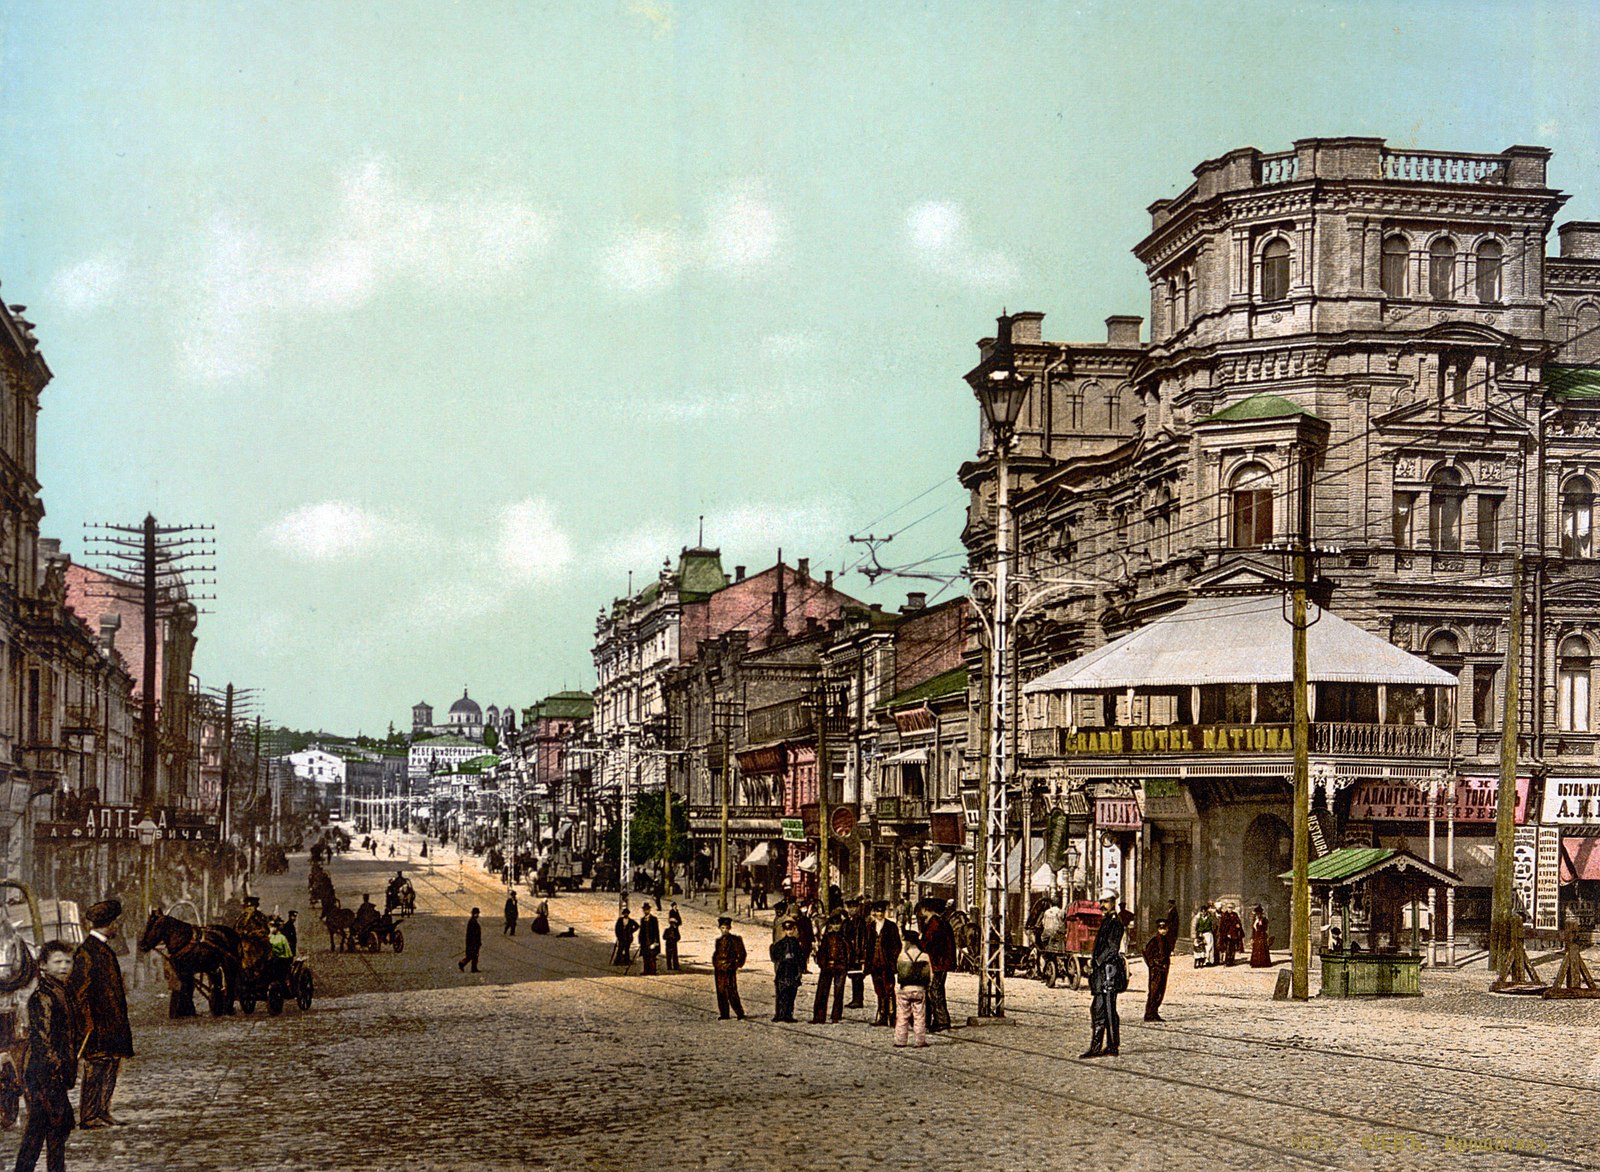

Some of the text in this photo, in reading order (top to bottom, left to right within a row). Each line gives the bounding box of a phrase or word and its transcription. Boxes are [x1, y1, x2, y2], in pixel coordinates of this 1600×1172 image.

[1066, 731, 1122, 751] GRAND
[1203, 727, 1293, 751] NATIONA
[1558, 783, 1600, 796] ОБУВЬ МУ
[86, 809, 167, 829] АПТЕА
[72, 827, 203, 841] ФИЛИПВИЧА
